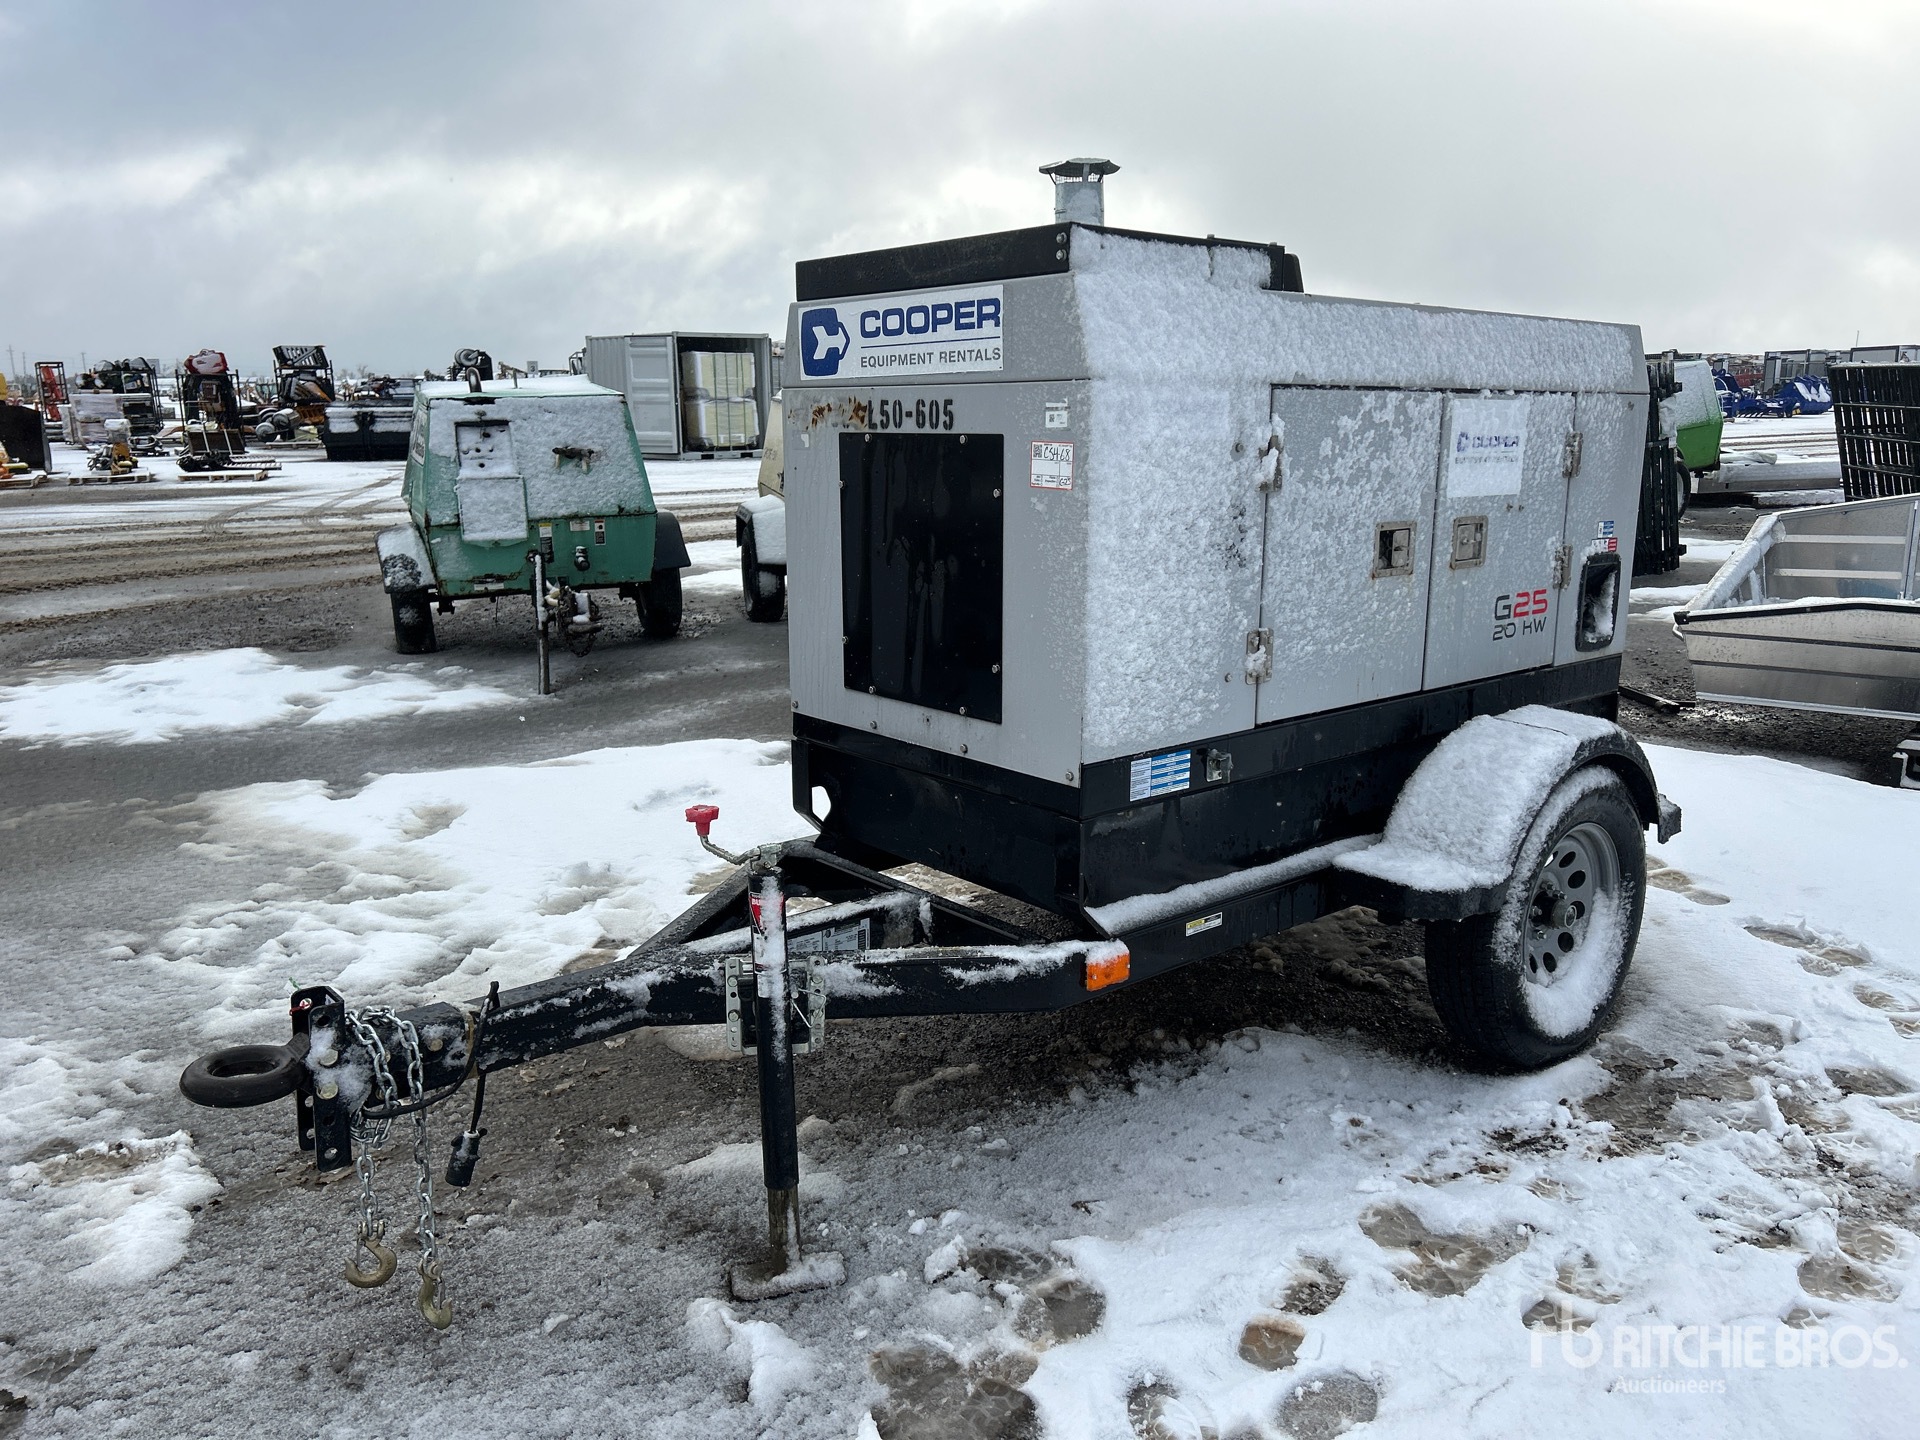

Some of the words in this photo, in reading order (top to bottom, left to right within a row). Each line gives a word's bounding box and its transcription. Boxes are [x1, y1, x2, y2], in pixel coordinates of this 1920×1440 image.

[860, 298, 1001, 339] COOPER
[861, 352, 934, 368] EQUIPMENT
[940, 347, 1001, 364] RENTALS
[867, 398, 954, 431] L50-605
[1494, 589, 1548, 621] G25
[1492, 622, 1517, 641] 20
